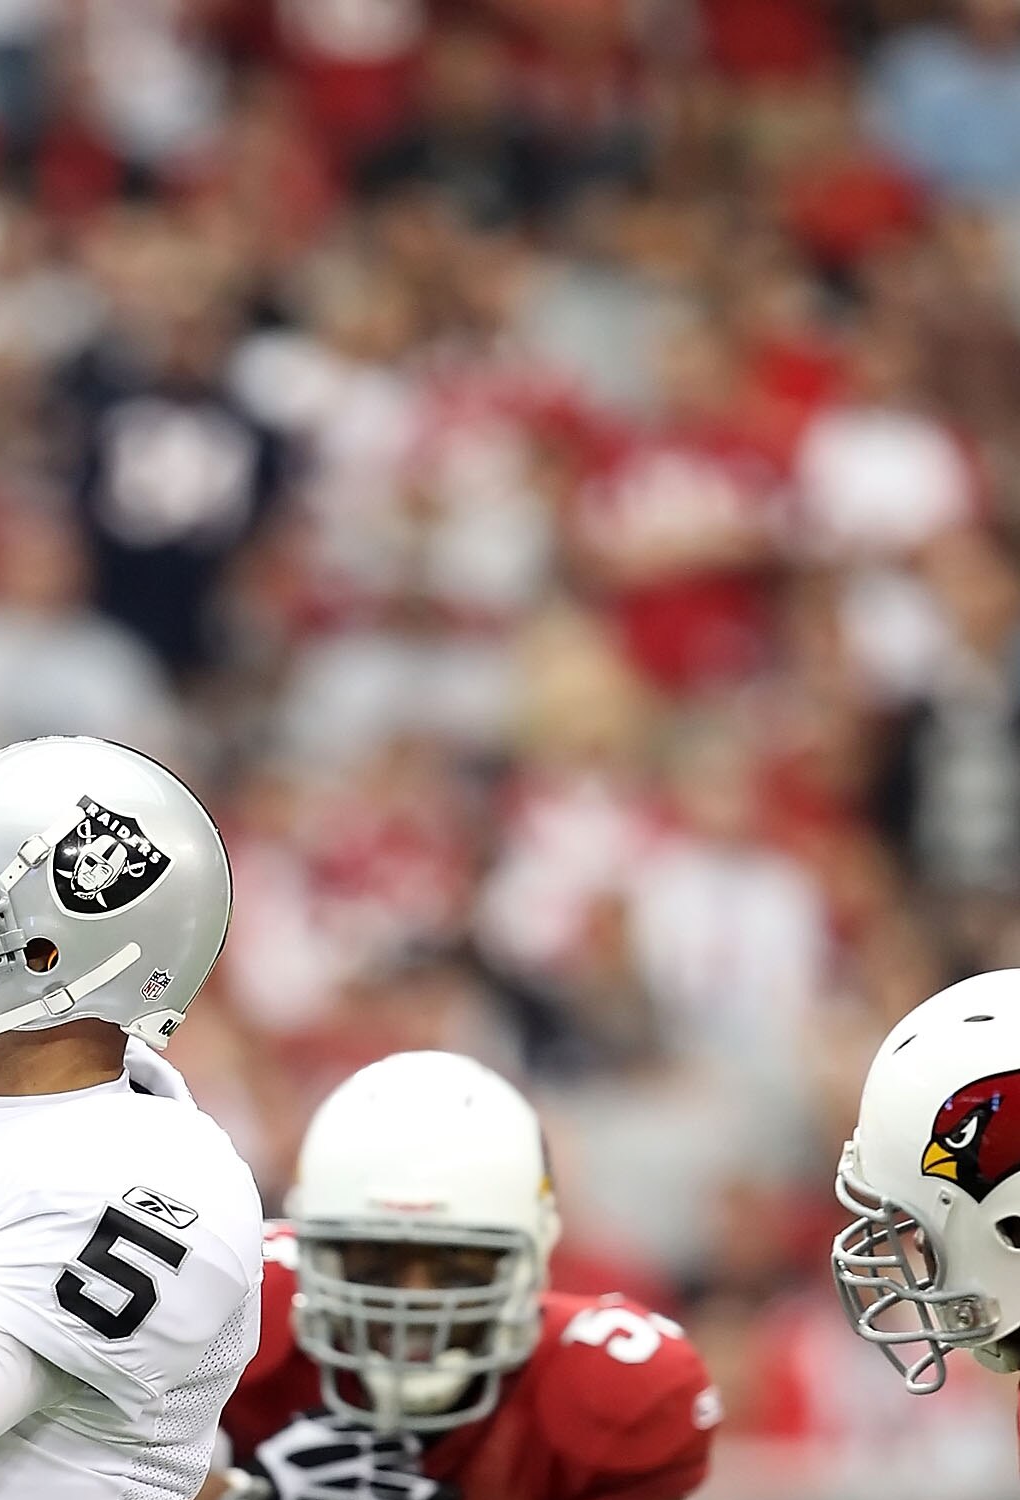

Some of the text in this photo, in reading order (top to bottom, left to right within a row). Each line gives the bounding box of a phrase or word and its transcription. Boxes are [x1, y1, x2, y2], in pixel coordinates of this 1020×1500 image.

[85, 802, 162, 865] RAIDERS
[143, 980, 164, 998] NFL
[54, 1205, 188, 1340] 5
